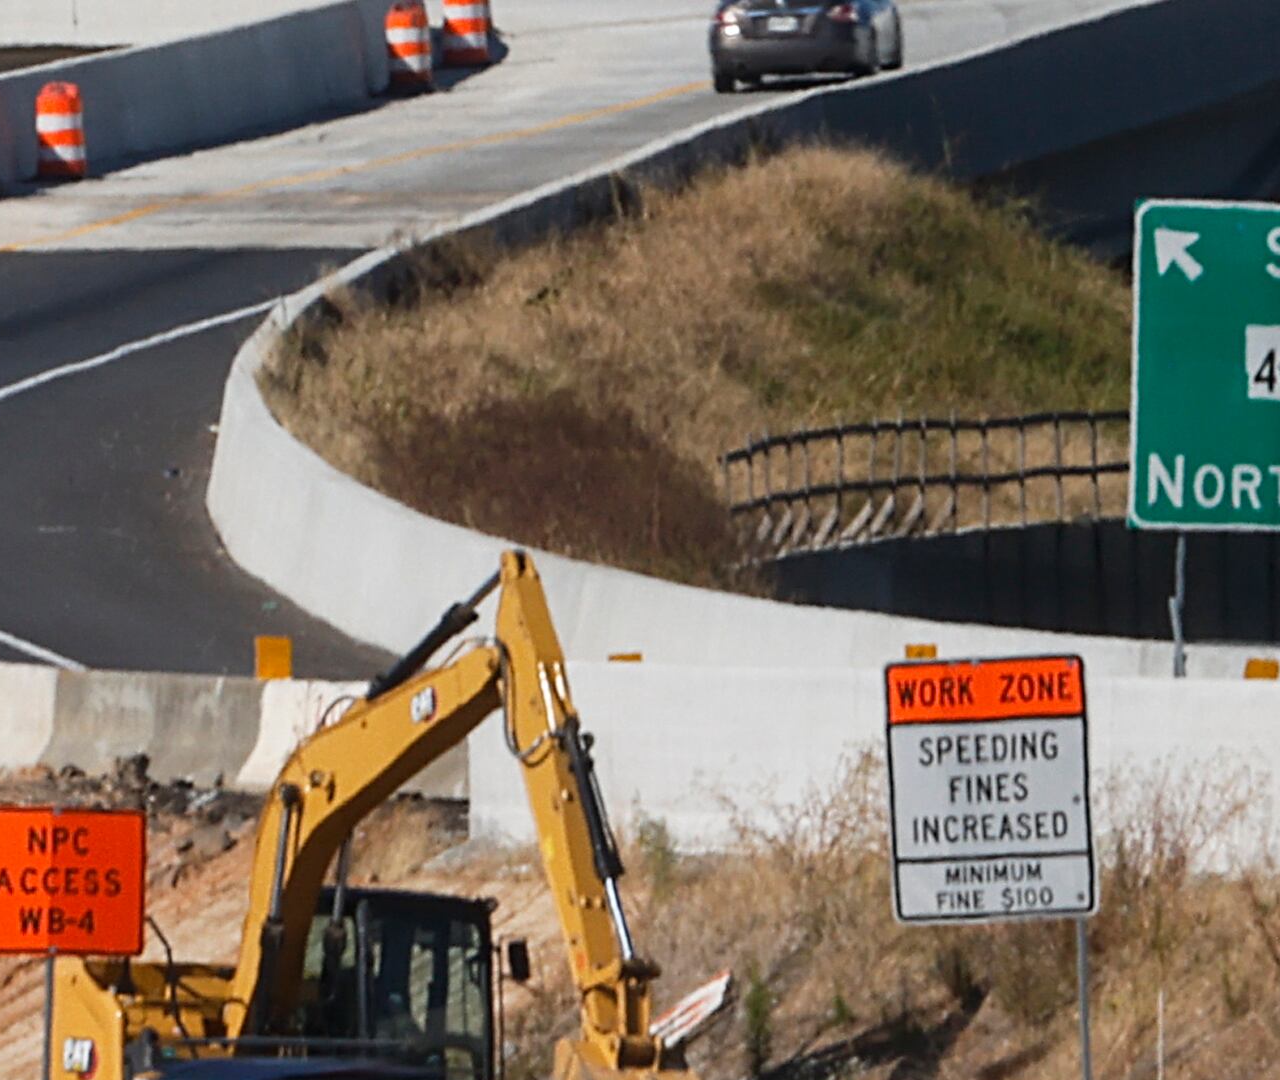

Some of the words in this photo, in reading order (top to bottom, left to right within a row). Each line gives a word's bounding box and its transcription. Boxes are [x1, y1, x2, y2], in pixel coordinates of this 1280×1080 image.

[896, 675, 974, 709] WORK
[998, 671, 1073, 704] ZONE
[918, 730, 1060, 767] SPEEDING
[948, 771, 1029, 804] FINES
[27, 826, 90, 856] NPC
[912, 810, 1069, 844] INCREASED
[944, 861, 1043, 886] MINIMUM
[936, 889, 985, 911] FINE
[1001, 886, 1054, 911] $100
[19, 906, 96, 936] WB-4
